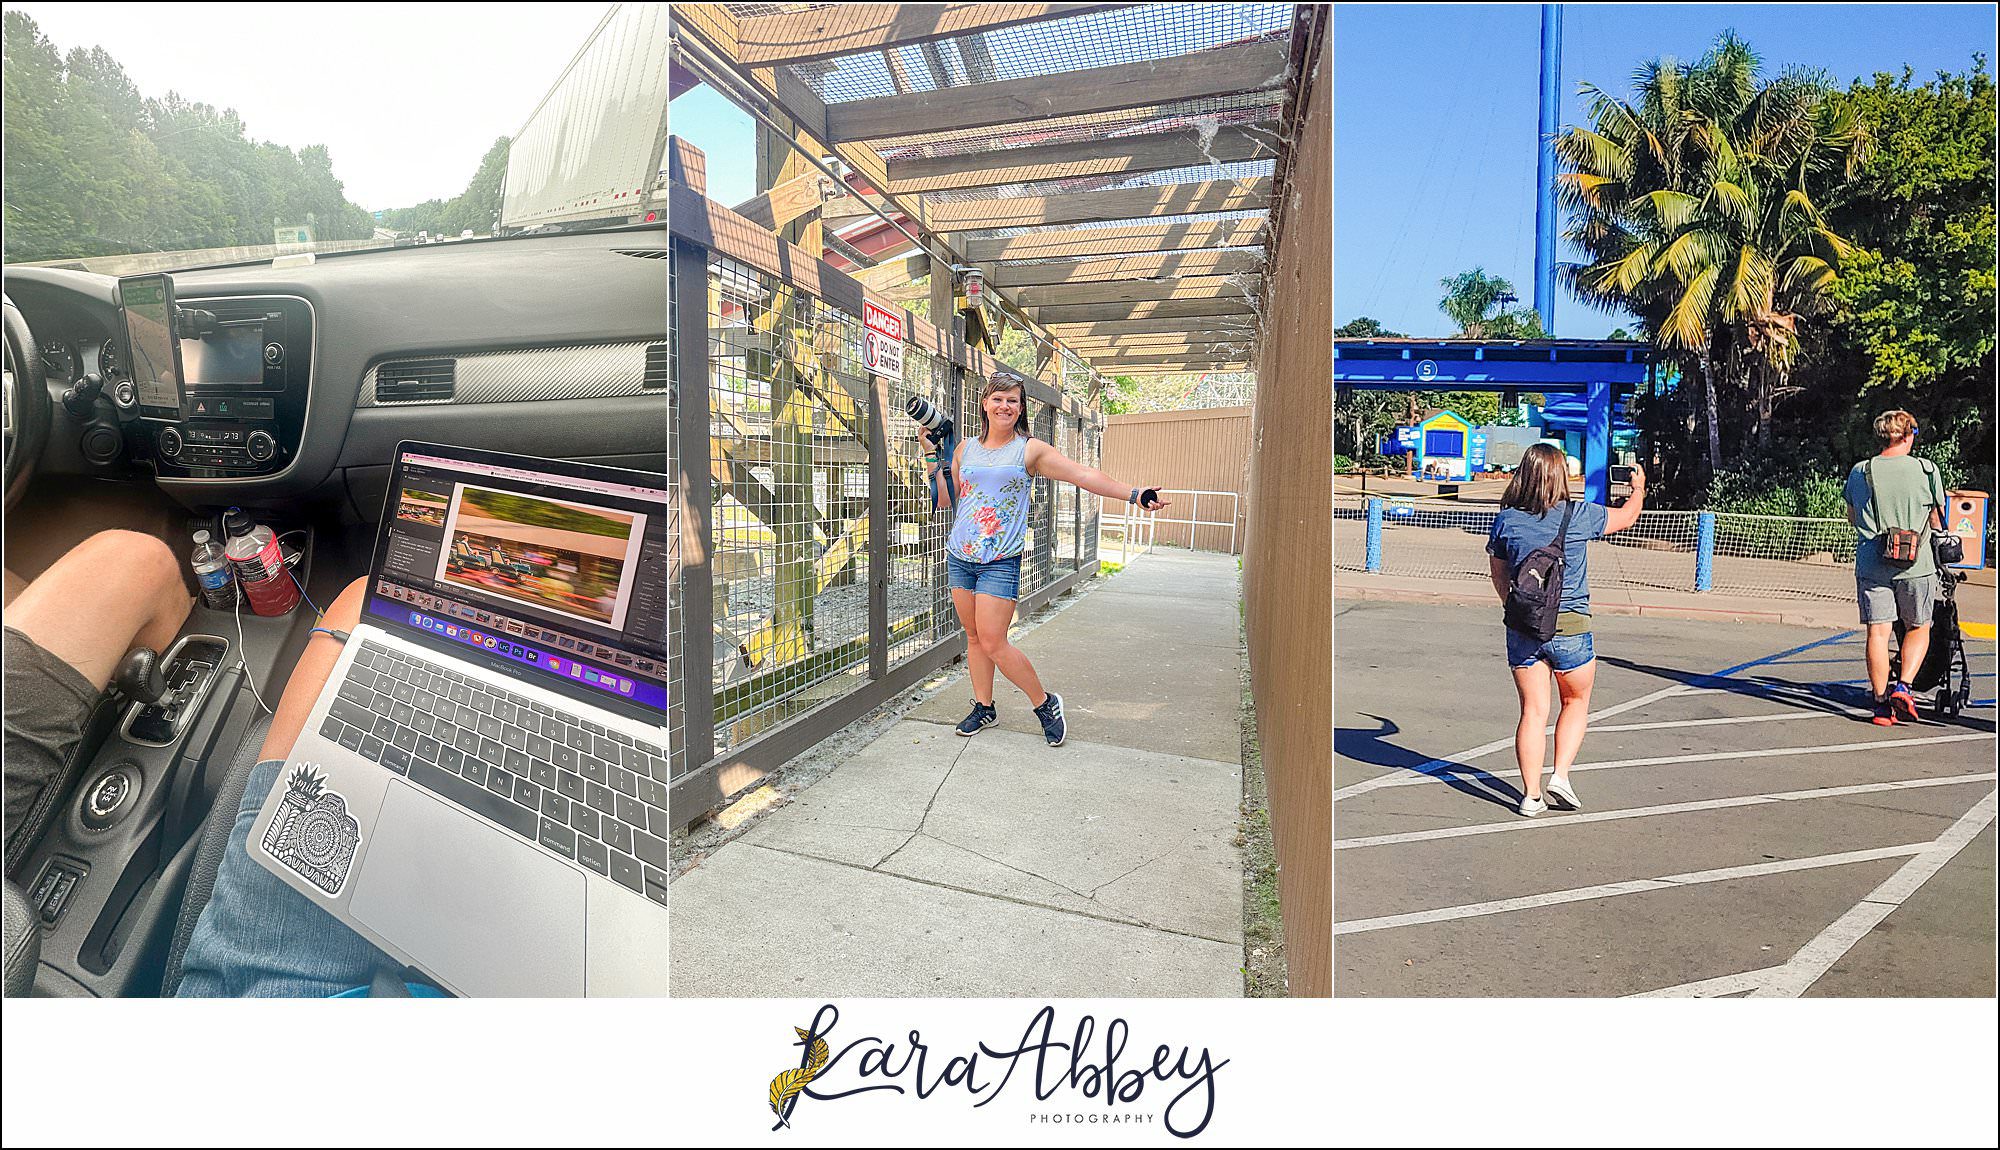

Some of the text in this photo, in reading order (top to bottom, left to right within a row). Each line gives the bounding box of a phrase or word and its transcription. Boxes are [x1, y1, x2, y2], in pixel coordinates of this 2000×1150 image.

[866, 305, 899, 338] DANGER
[880, 340, 900, 358] DO NOT
[880, 354, 900, 372] ENTER
[1422, 364, 1431, 374] 5
[491, 662, 512, 673] MacBook
[342, 738, 356, 748] control
[364, 749, 377, 758] option
[384, 759, 404, 771] command
[523, 789, 530, 798] M
[543, 836, 571, 853] command
[582, 855, 601, 868] option
